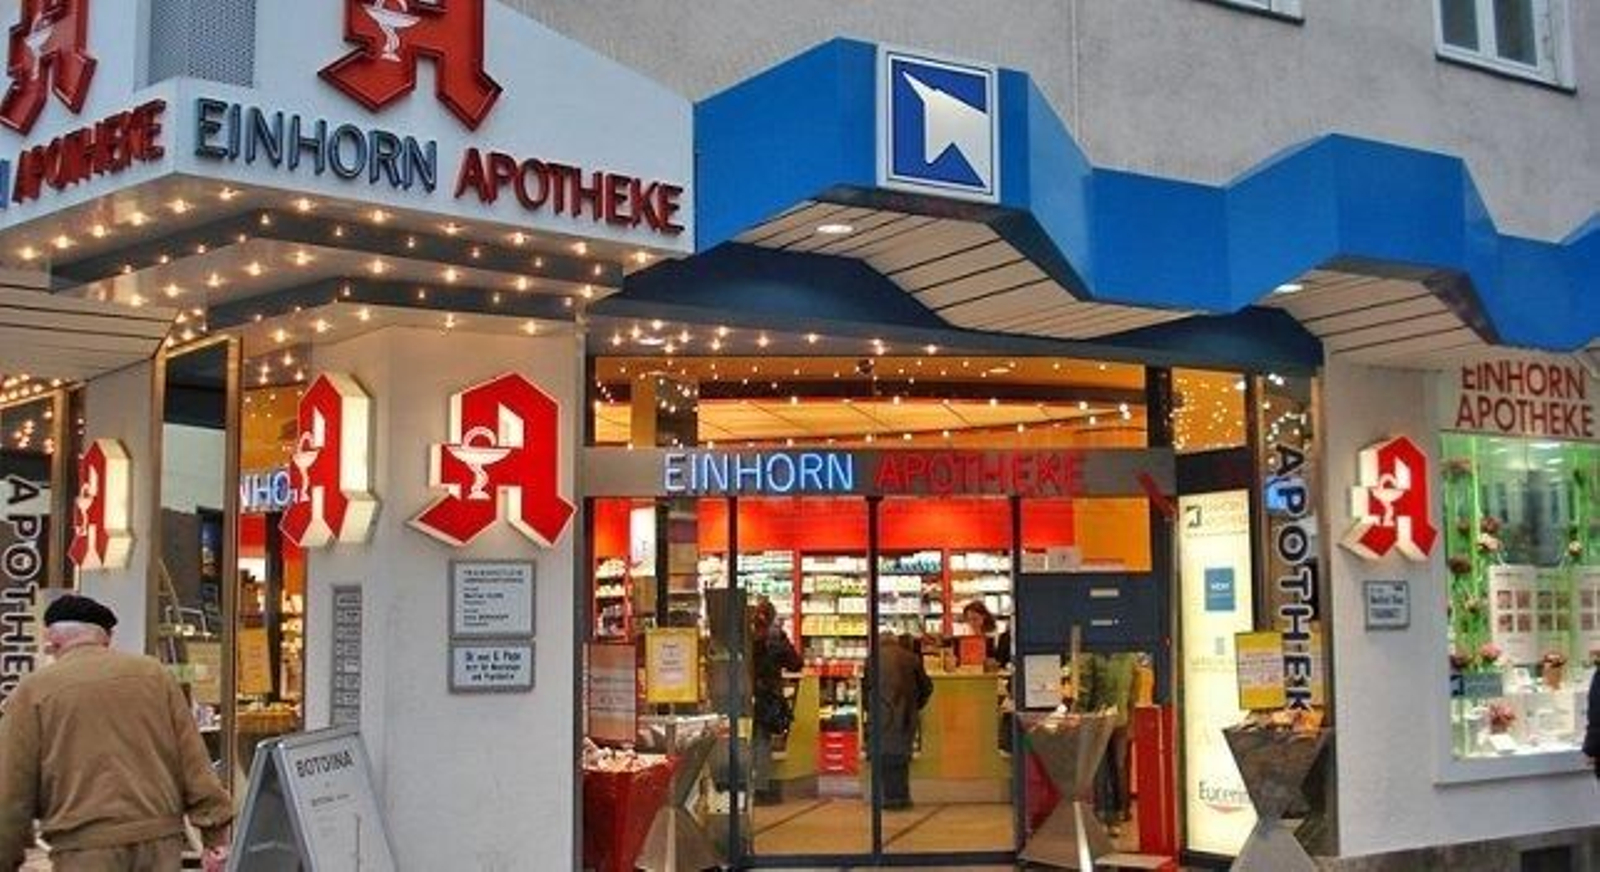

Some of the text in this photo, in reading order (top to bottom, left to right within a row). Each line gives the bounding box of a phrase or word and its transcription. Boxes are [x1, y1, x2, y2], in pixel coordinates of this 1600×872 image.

[12, 99, 166, 203] APOTHEKE
[195, 98, 685, 235] EINHORN APOTHEKE
[1462, 359, 1586, 400] EINHORN
[1455, 393, 1593, 437] APOTHEKE
[663, 451, 1084, 496] EINHORN APOTHEKE
